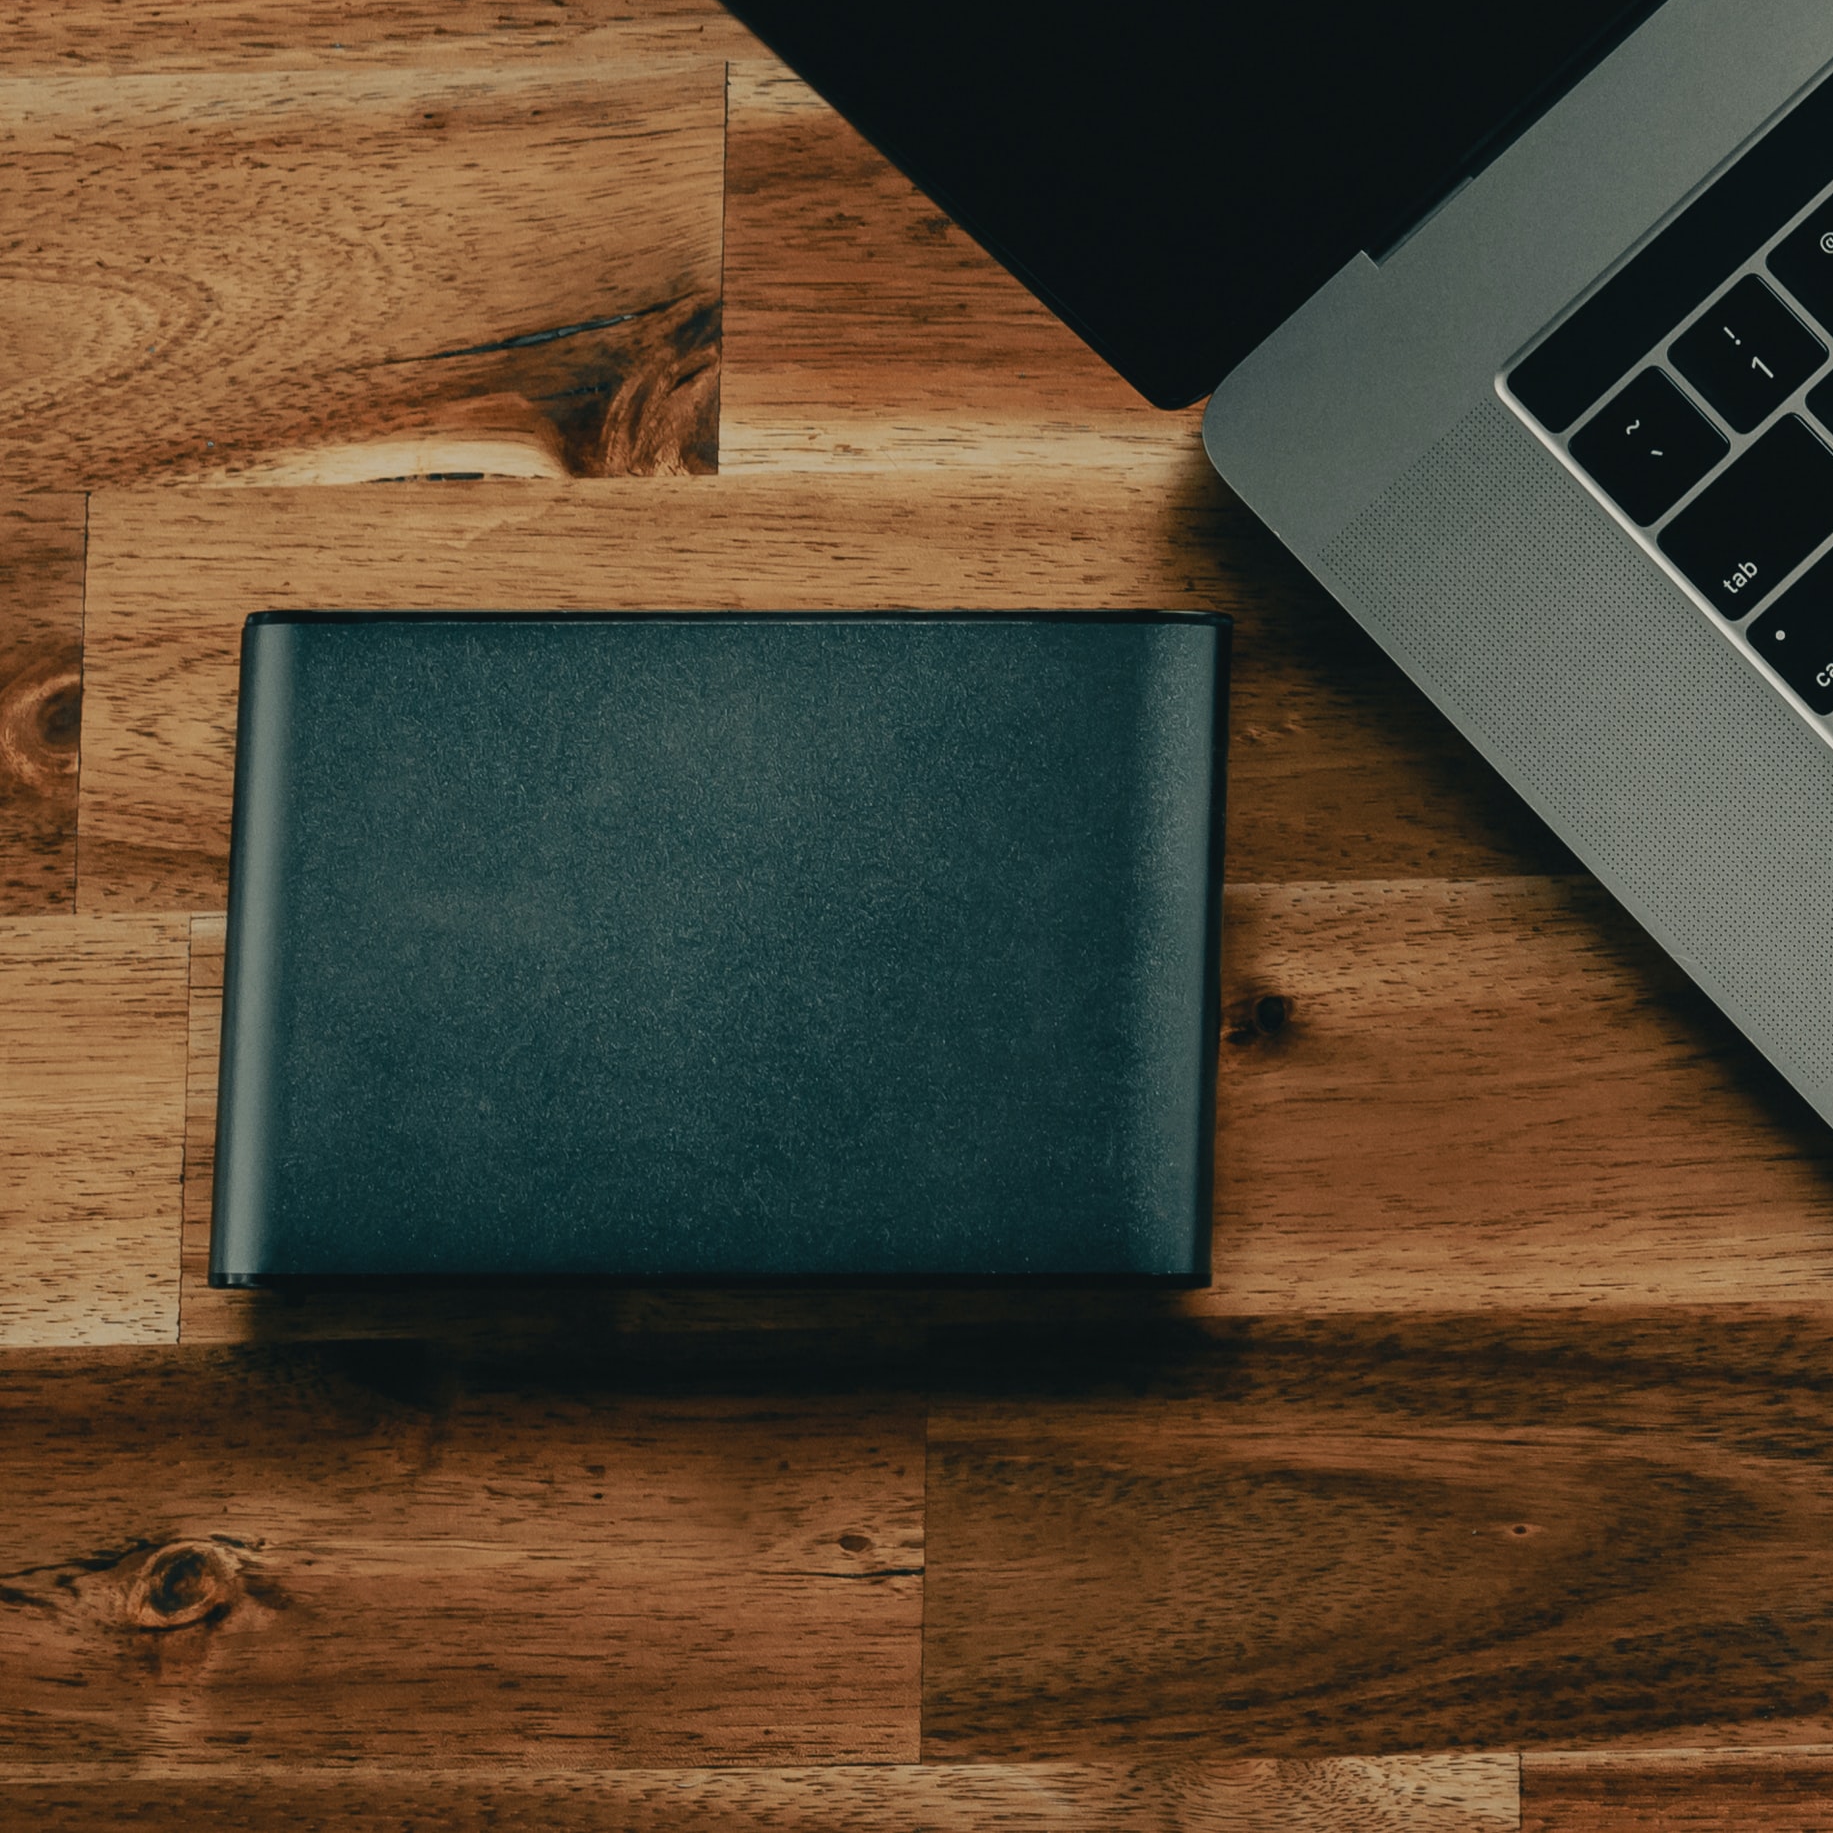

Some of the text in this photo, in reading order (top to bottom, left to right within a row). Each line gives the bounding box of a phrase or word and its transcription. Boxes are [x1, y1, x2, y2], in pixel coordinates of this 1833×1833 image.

[1723, 325, 1742, 346] !
[1751, 355, 1775, 379] 1
[1722, 561, 1758, 594] tab
